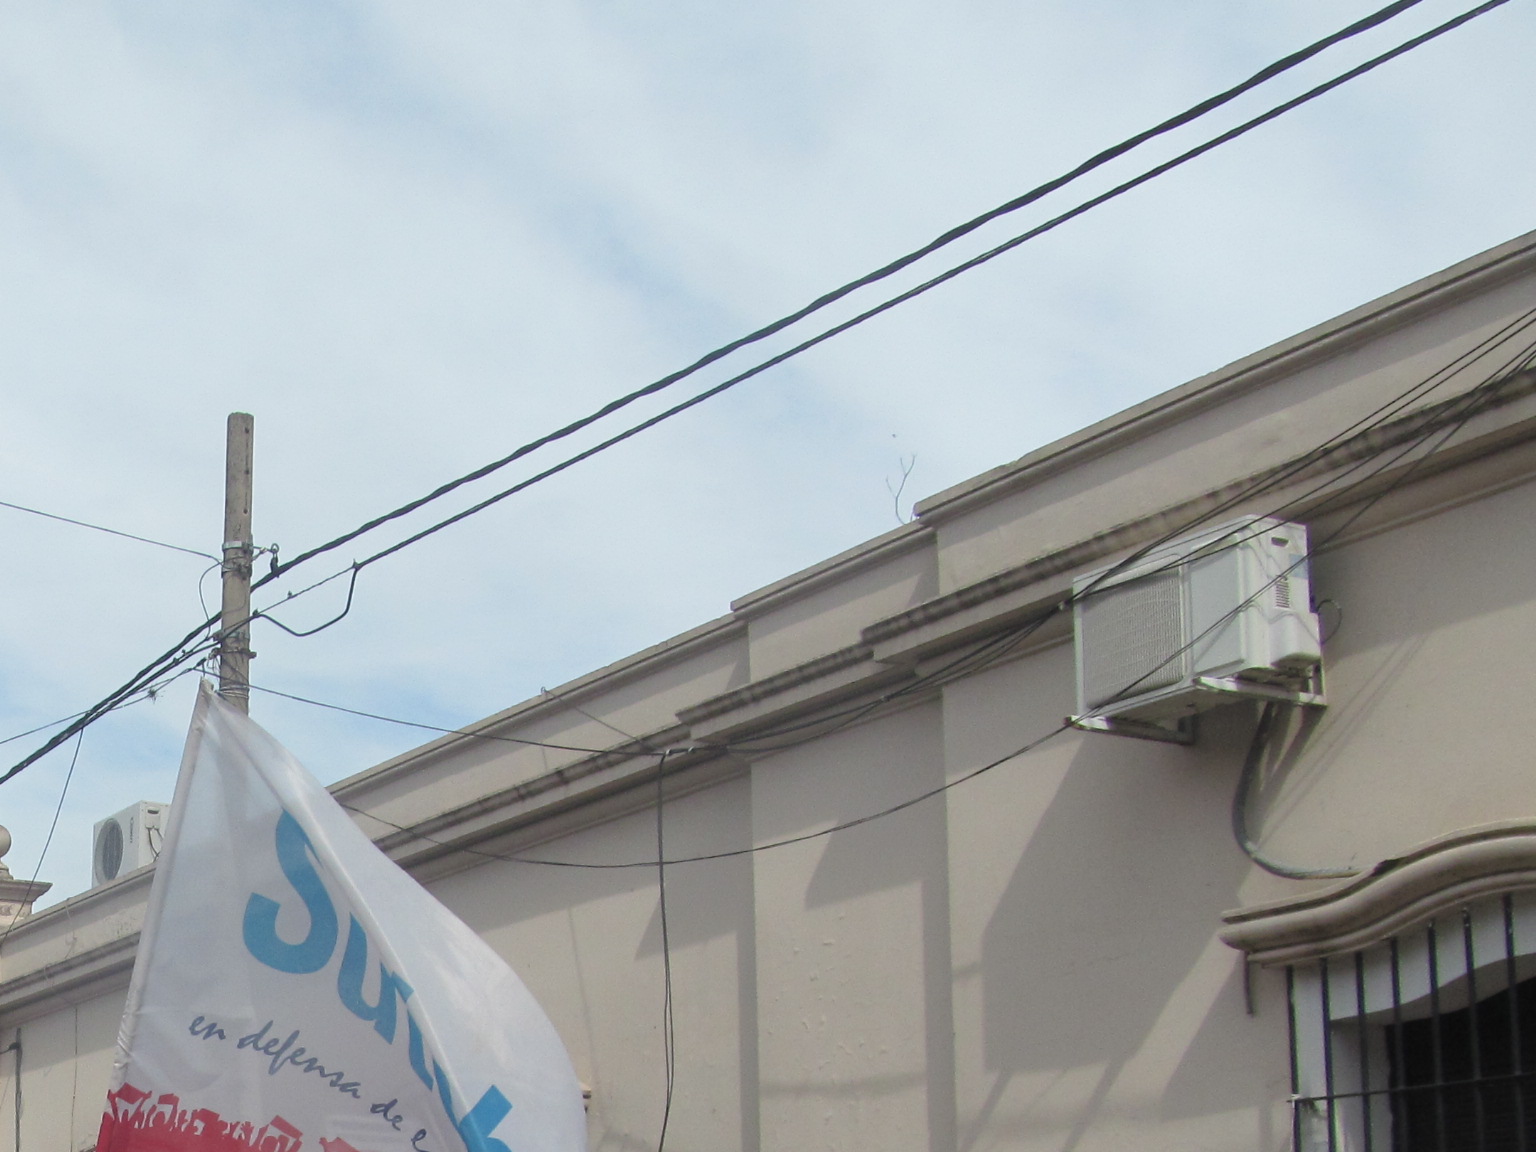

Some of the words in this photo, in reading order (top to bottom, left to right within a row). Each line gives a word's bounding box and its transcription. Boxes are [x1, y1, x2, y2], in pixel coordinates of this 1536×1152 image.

[189, 1014, 227, 1041] en
[236, 1019, 362, 1100] defensa
[370, 1099, 403, 1132] de
